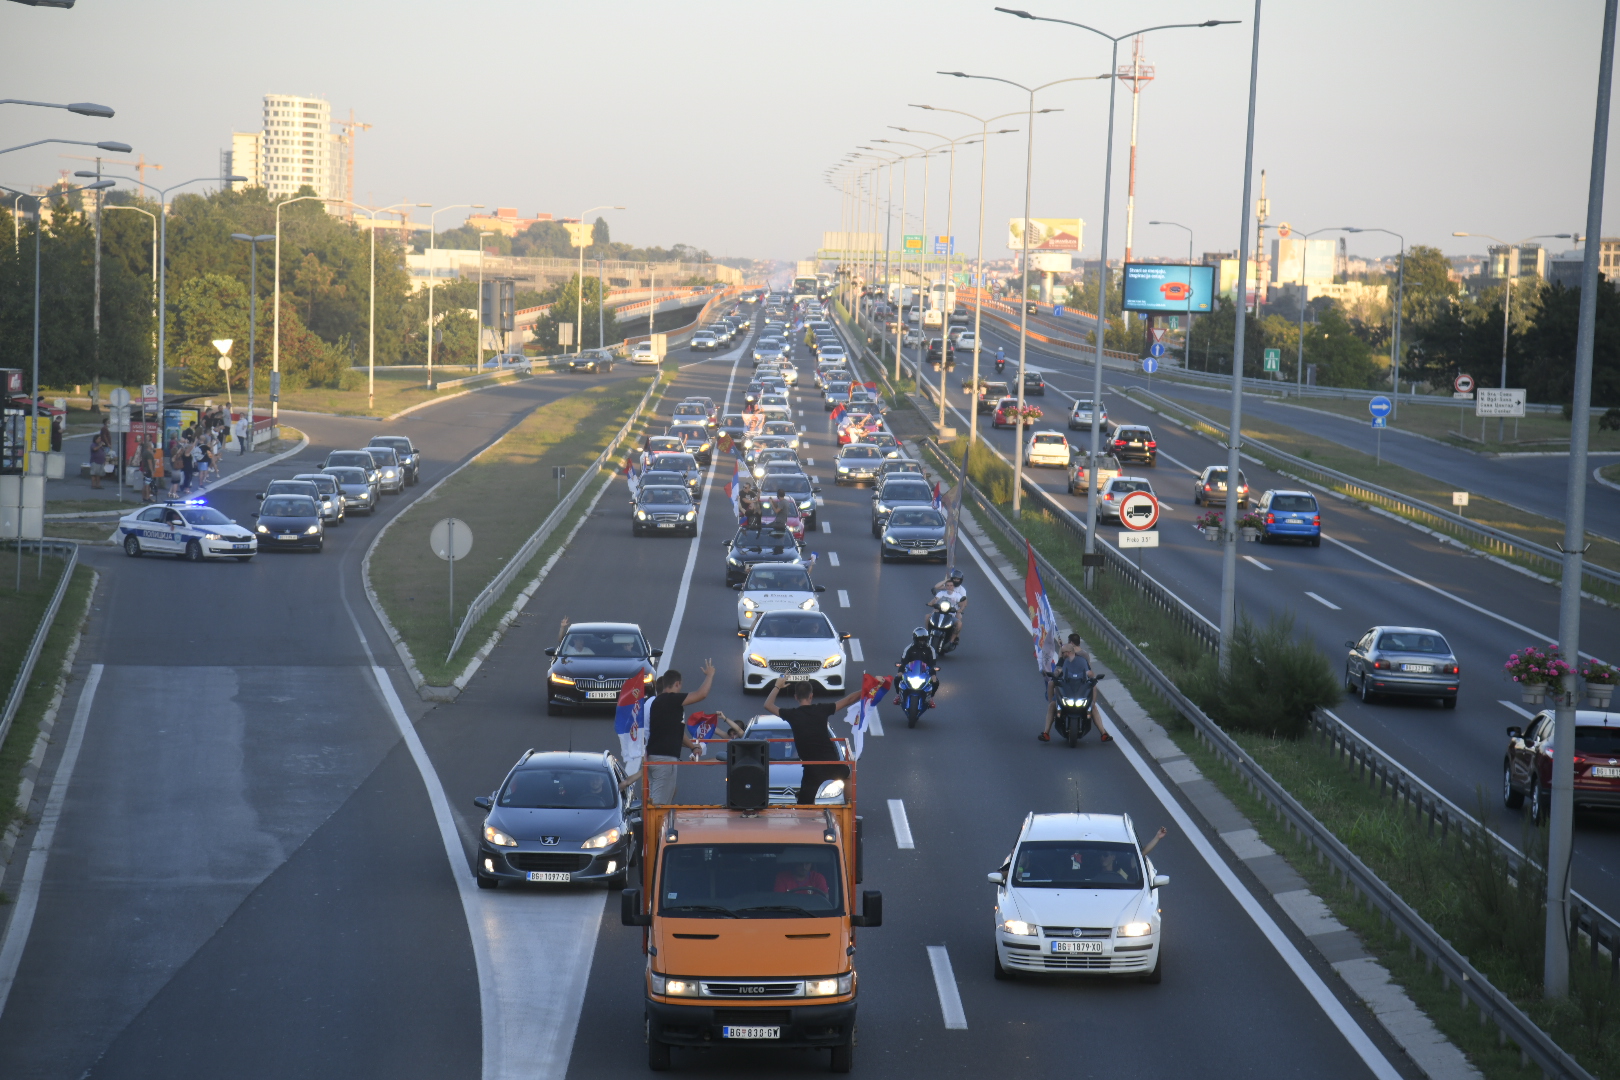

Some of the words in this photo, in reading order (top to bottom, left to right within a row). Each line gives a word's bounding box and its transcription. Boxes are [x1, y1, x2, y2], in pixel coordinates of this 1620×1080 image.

[143, 530, 173, 540] ПОЛИЦИЈА
[531, 872, 540, 880] BG
[1057, 942, 1067, 951] BG
[739, 986, 765, 994] IVECO
[730, 1028, 741, 1038] BG
